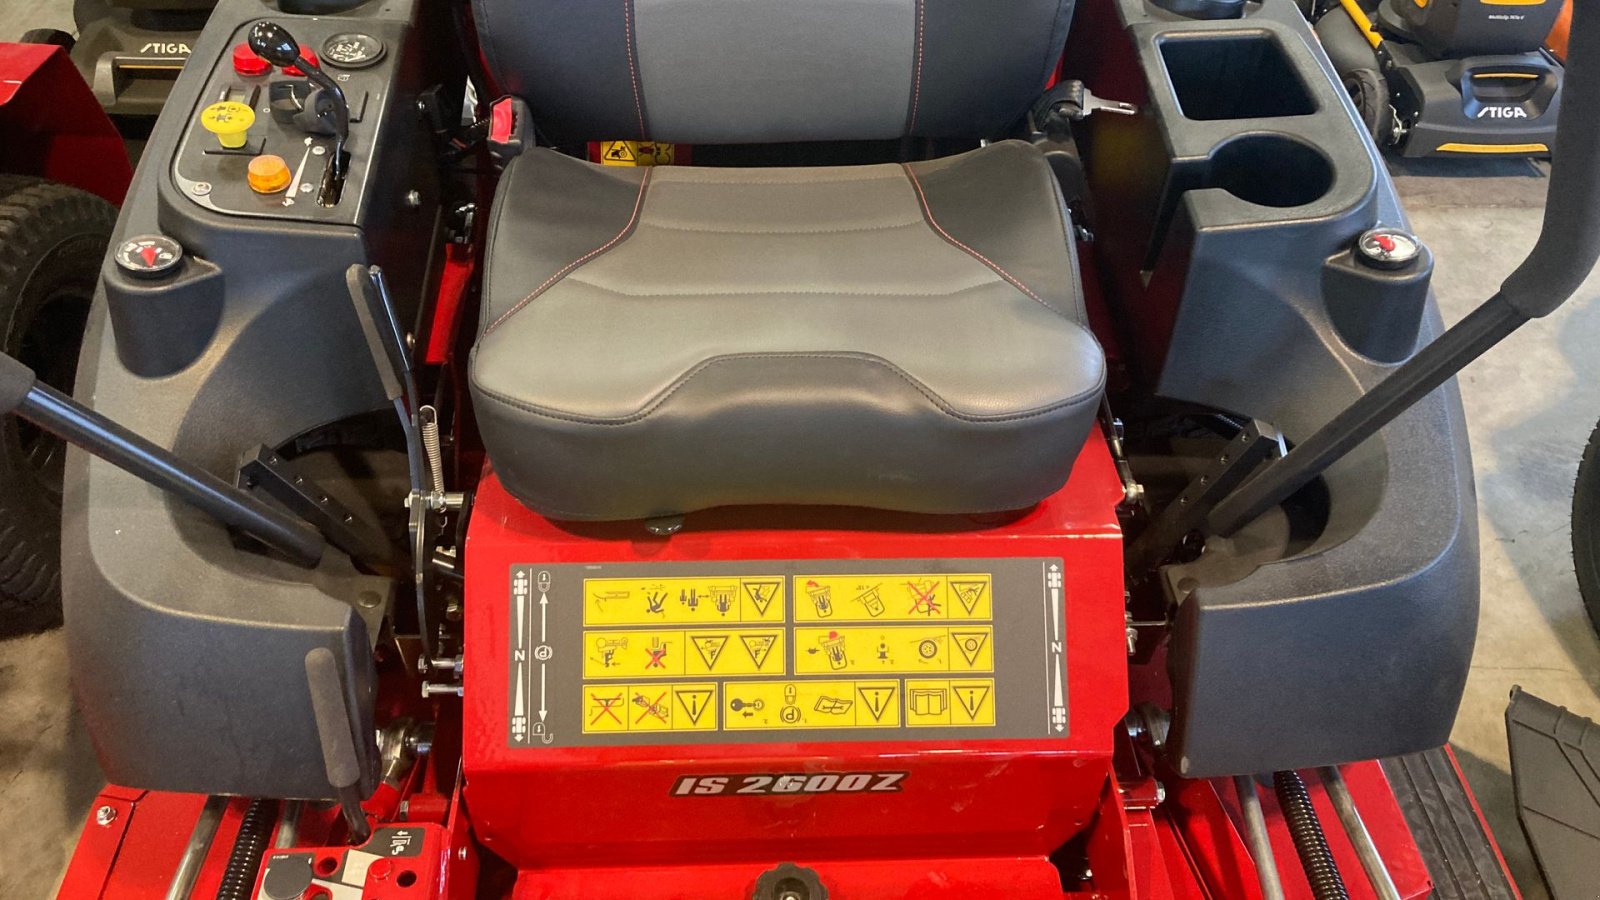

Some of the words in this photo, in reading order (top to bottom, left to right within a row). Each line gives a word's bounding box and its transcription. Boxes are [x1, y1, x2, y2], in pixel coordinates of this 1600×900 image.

[141, 43, 192, 54] STIGA
[1477, 106, 1527, 118] STIGA
[1052, 641, 1062, 653] N
[515, 650, 525, 661] N
[675, 777, 729, 795] IS
[736, 773, 905, 793] 2600Z
